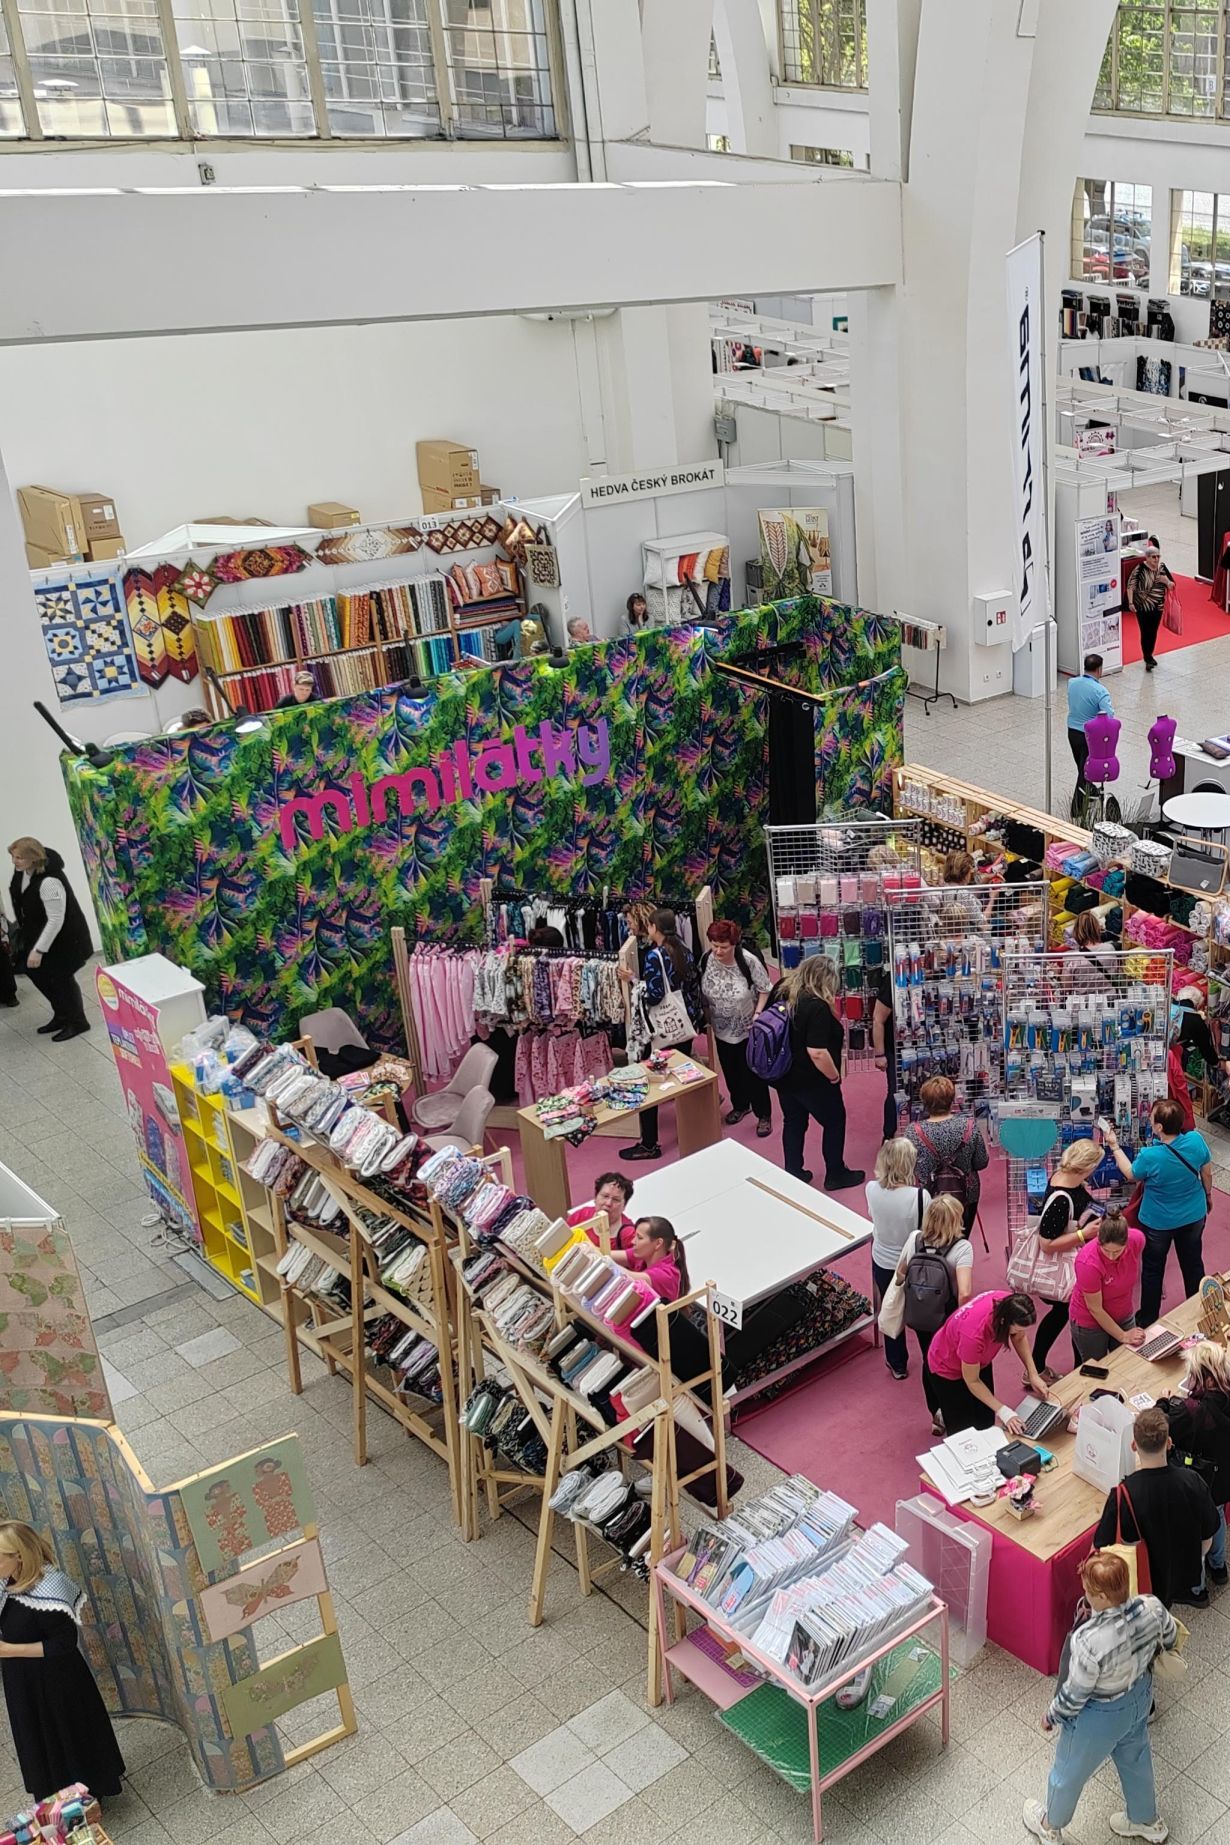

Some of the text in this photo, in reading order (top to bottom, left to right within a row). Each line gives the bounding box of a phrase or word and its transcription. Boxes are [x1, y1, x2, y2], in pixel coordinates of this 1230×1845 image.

[590, 467, 715, 498] HEDVA ČESKÝ BROKÁT
[280, 717, 611, 849] mimilátky
[712, 1300, 738, 1325] 022
